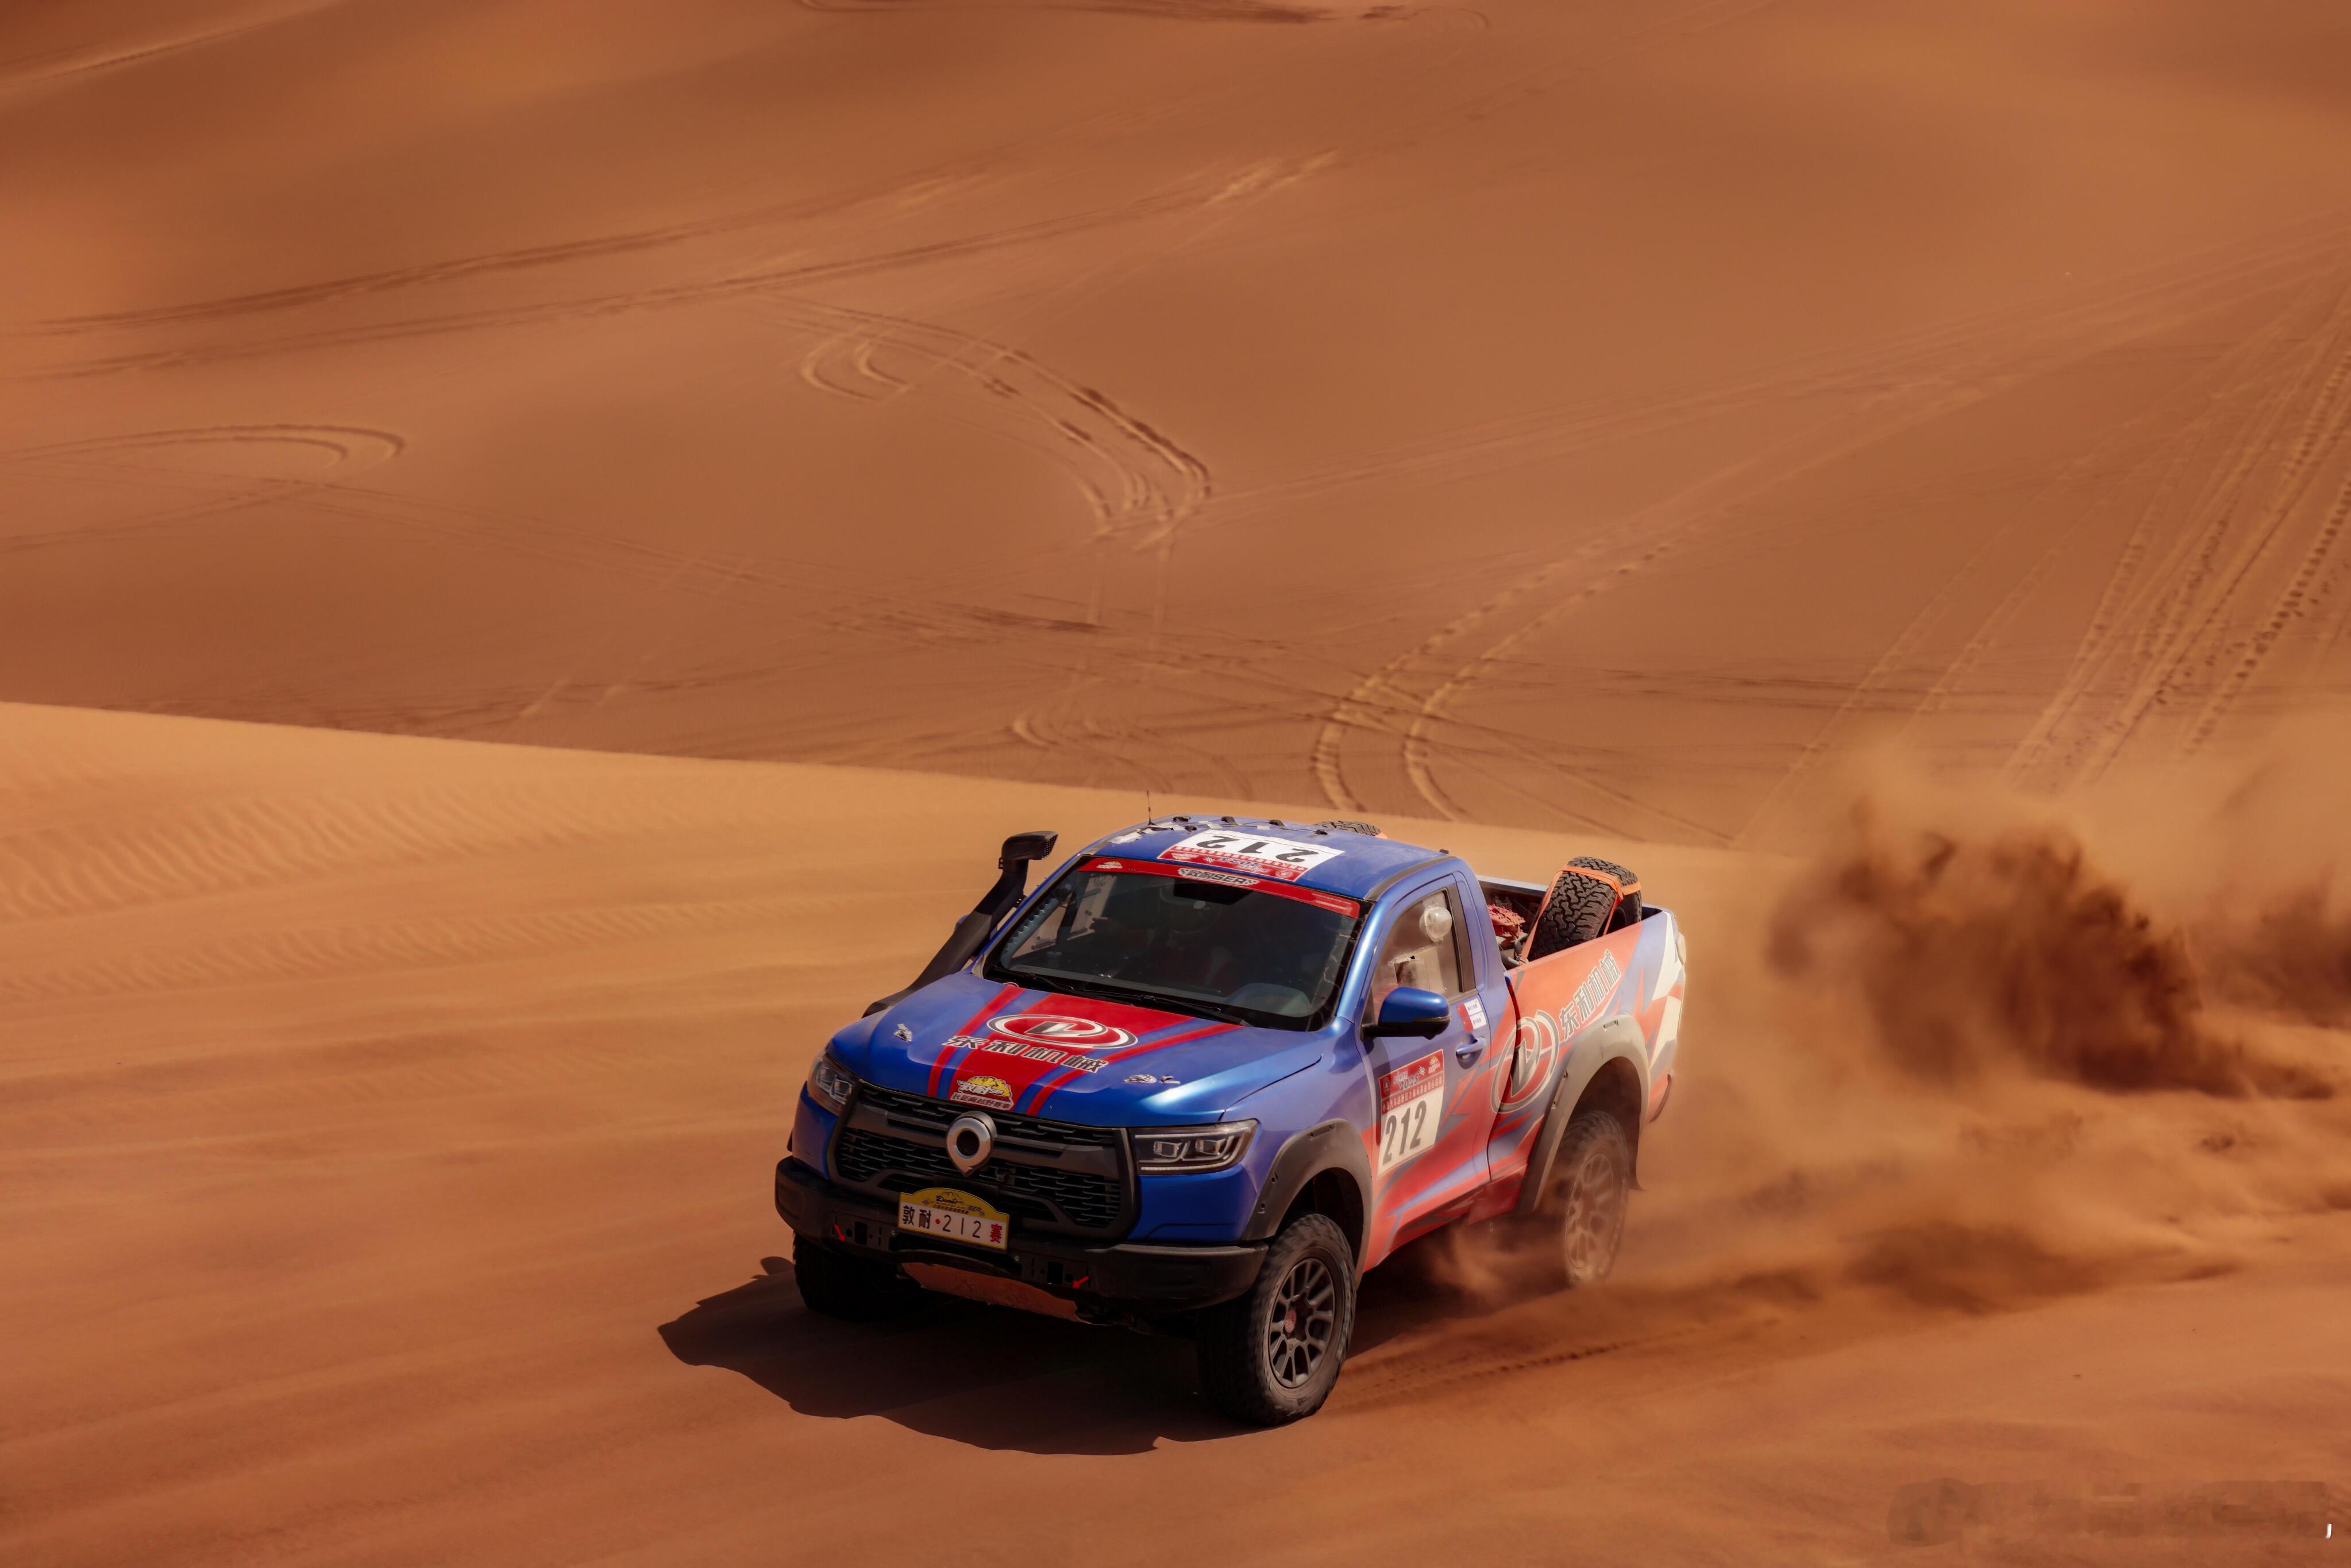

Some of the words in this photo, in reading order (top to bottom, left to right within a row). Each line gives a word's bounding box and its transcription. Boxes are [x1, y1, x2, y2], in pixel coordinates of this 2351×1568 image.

[1196, 836, 1319, 863] 212
[1559, 949, 1621, 1041] 东利机械
[943, 1036, 1108, 1073] 东利机械
[1382, 1100, 1427, 1165] 212
